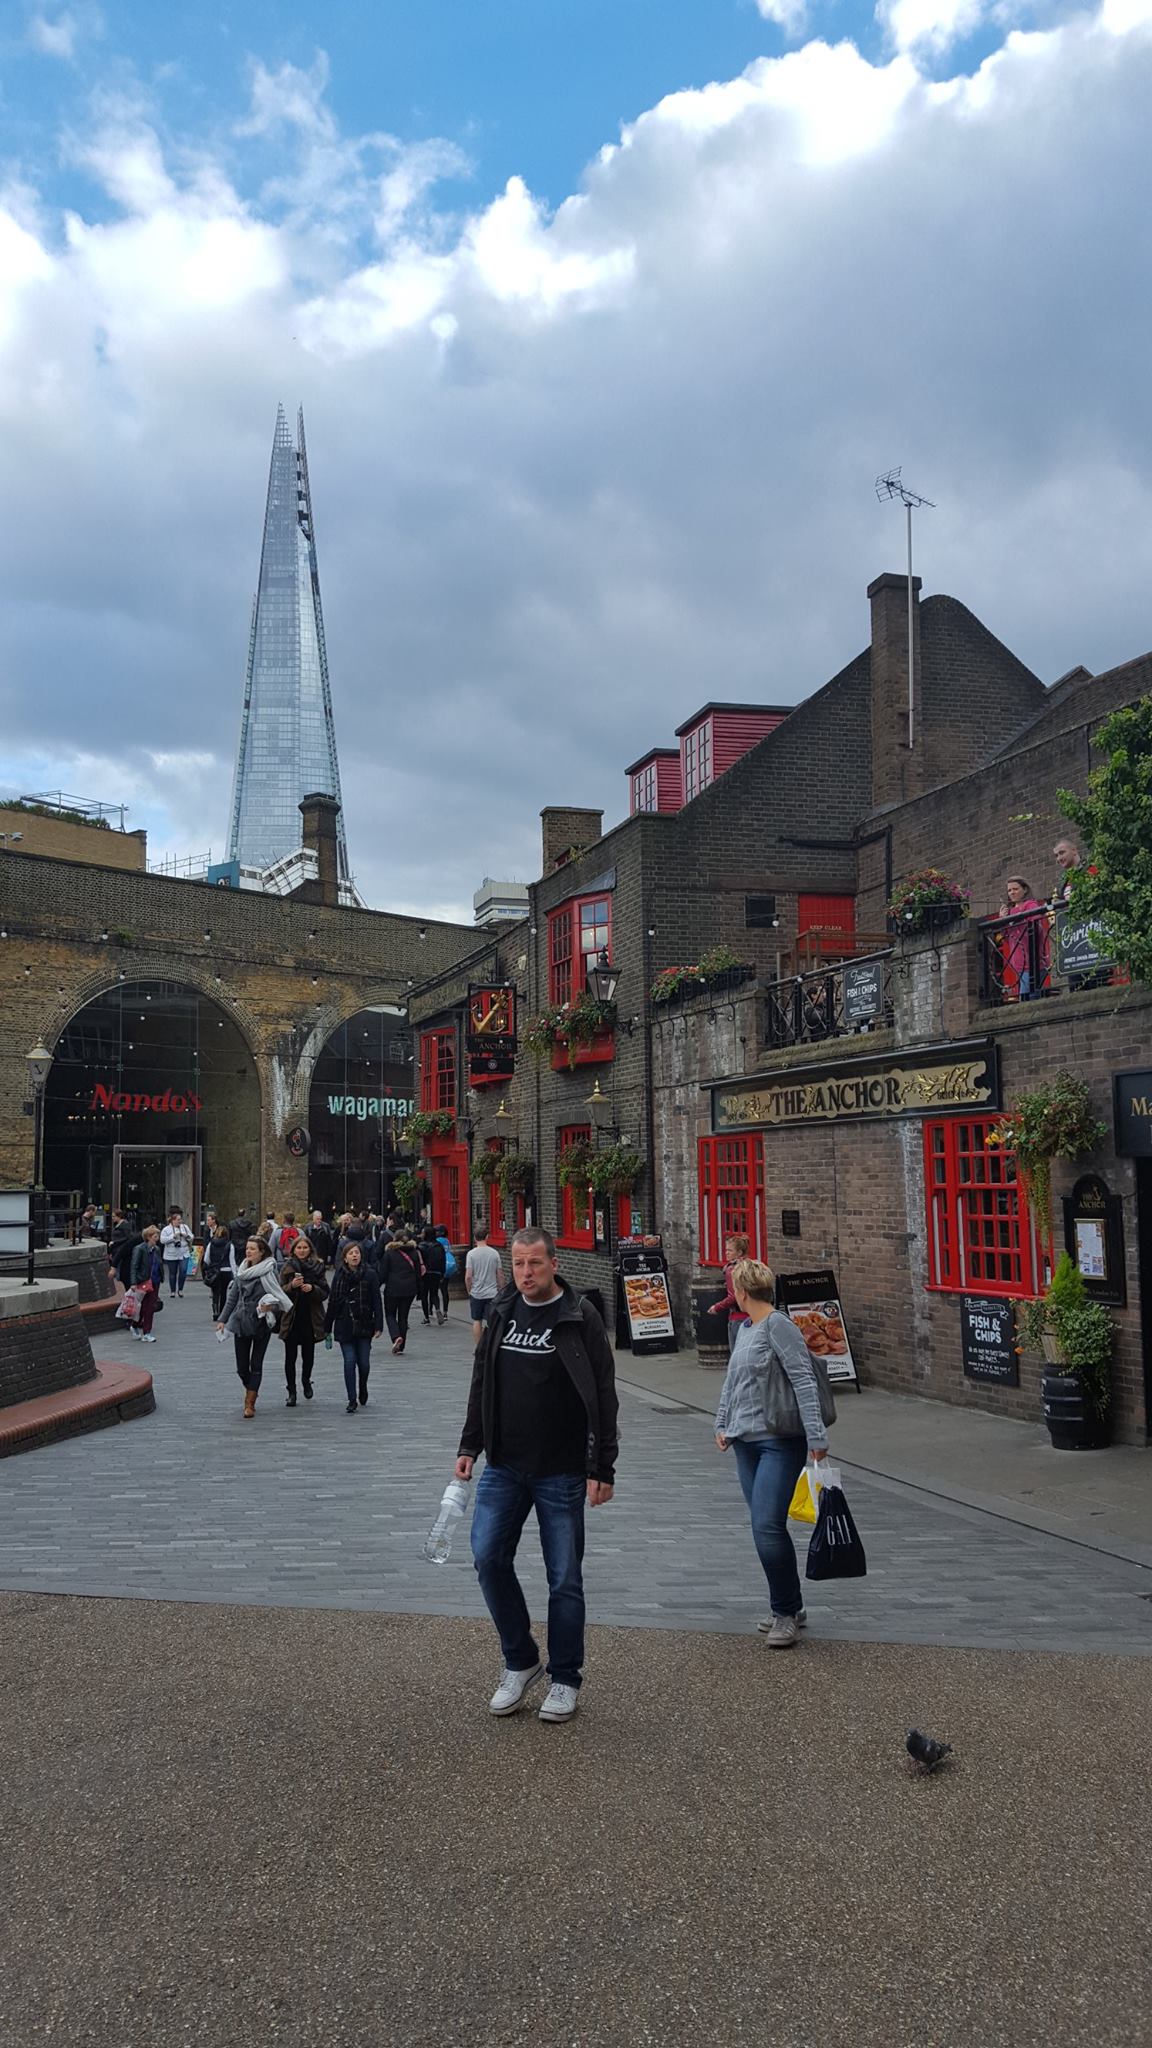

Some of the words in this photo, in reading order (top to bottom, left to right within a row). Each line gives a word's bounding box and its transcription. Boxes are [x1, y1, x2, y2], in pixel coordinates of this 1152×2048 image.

[846, 987, 858, 999] FISH
[861, 983, 878, 995] CHIPS
[88, 1083, 203, 1112] Nando's
[771, 1089, 807, 1117] THE
[813, 1077, 902, 1113] ANCHOR
[1078, 1200, 1106, 1209] ANCHOR
[786, 1279, 800, 1287] THE
[802, 1276, 829, 1286] ANCHOR
[968, 1315, 990, 1329] FISH
[992, 1317, 1002, 1332] &
[974, 1329, 1002, 1344] CHIPS
